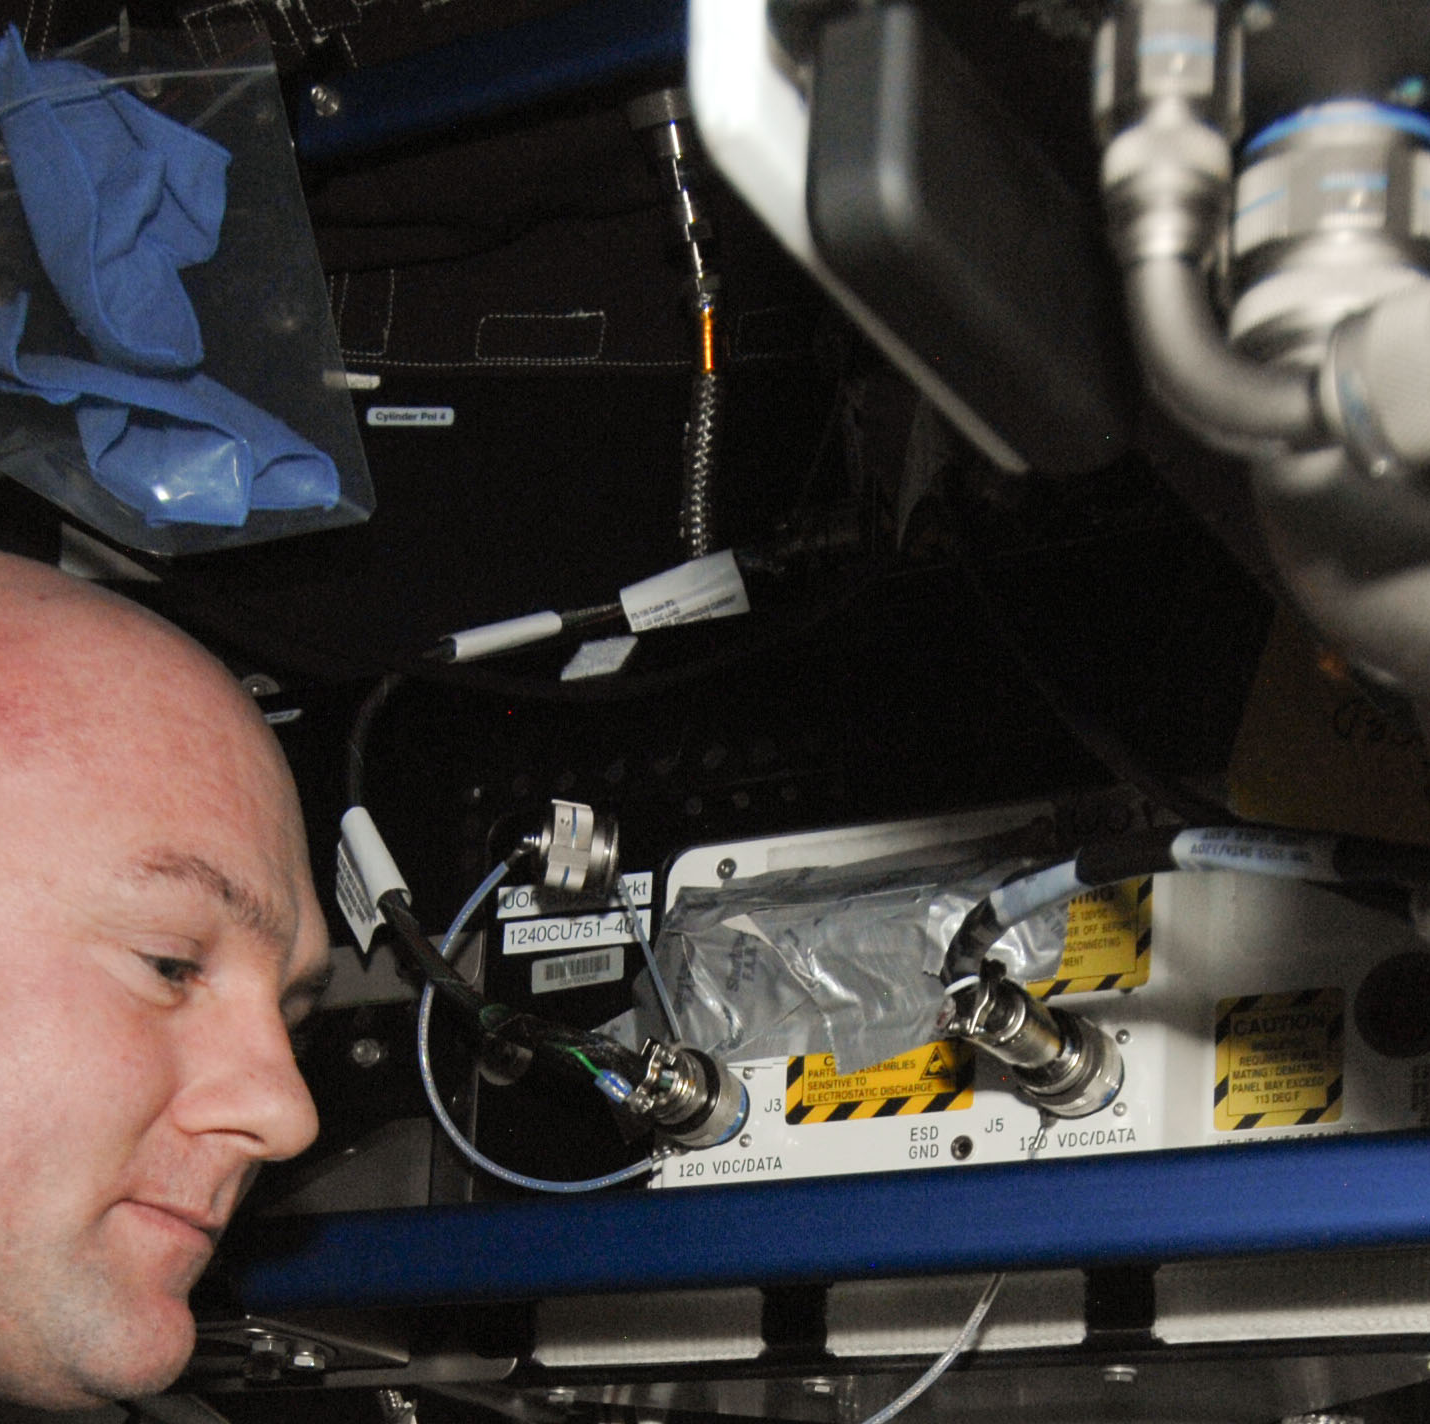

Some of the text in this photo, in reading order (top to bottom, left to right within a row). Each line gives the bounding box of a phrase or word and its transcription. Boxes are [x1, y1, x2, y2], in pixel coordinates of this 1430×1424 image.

[375, 411, 418, 423] Cylinder
[808, 1068, 837, 1079] PARTS
[807, 1077, 867, 1091] SENSITIVE TO
[1232, 1082, 1261, 1093] PANEL
[1264, 1080, 1284, 1091] MAY
[807, 1081, 934, 1103] ELECTROSTATIC DISCHARGE
[1272, 1092, 1292, 1103] DEG
[1294, 1090, 1300, 1101] F
[764, 1099, 782, 1113] J3
[985, 1118, 1005, 1133] J5
[910, 1126, 939, 1142] ESD
[1057, 1128, 1137, 1148] VDC/DATA
[908, 1143, 940, 1160] GND
[679, 1156, 783, 1178] 120 VDC/DATA
